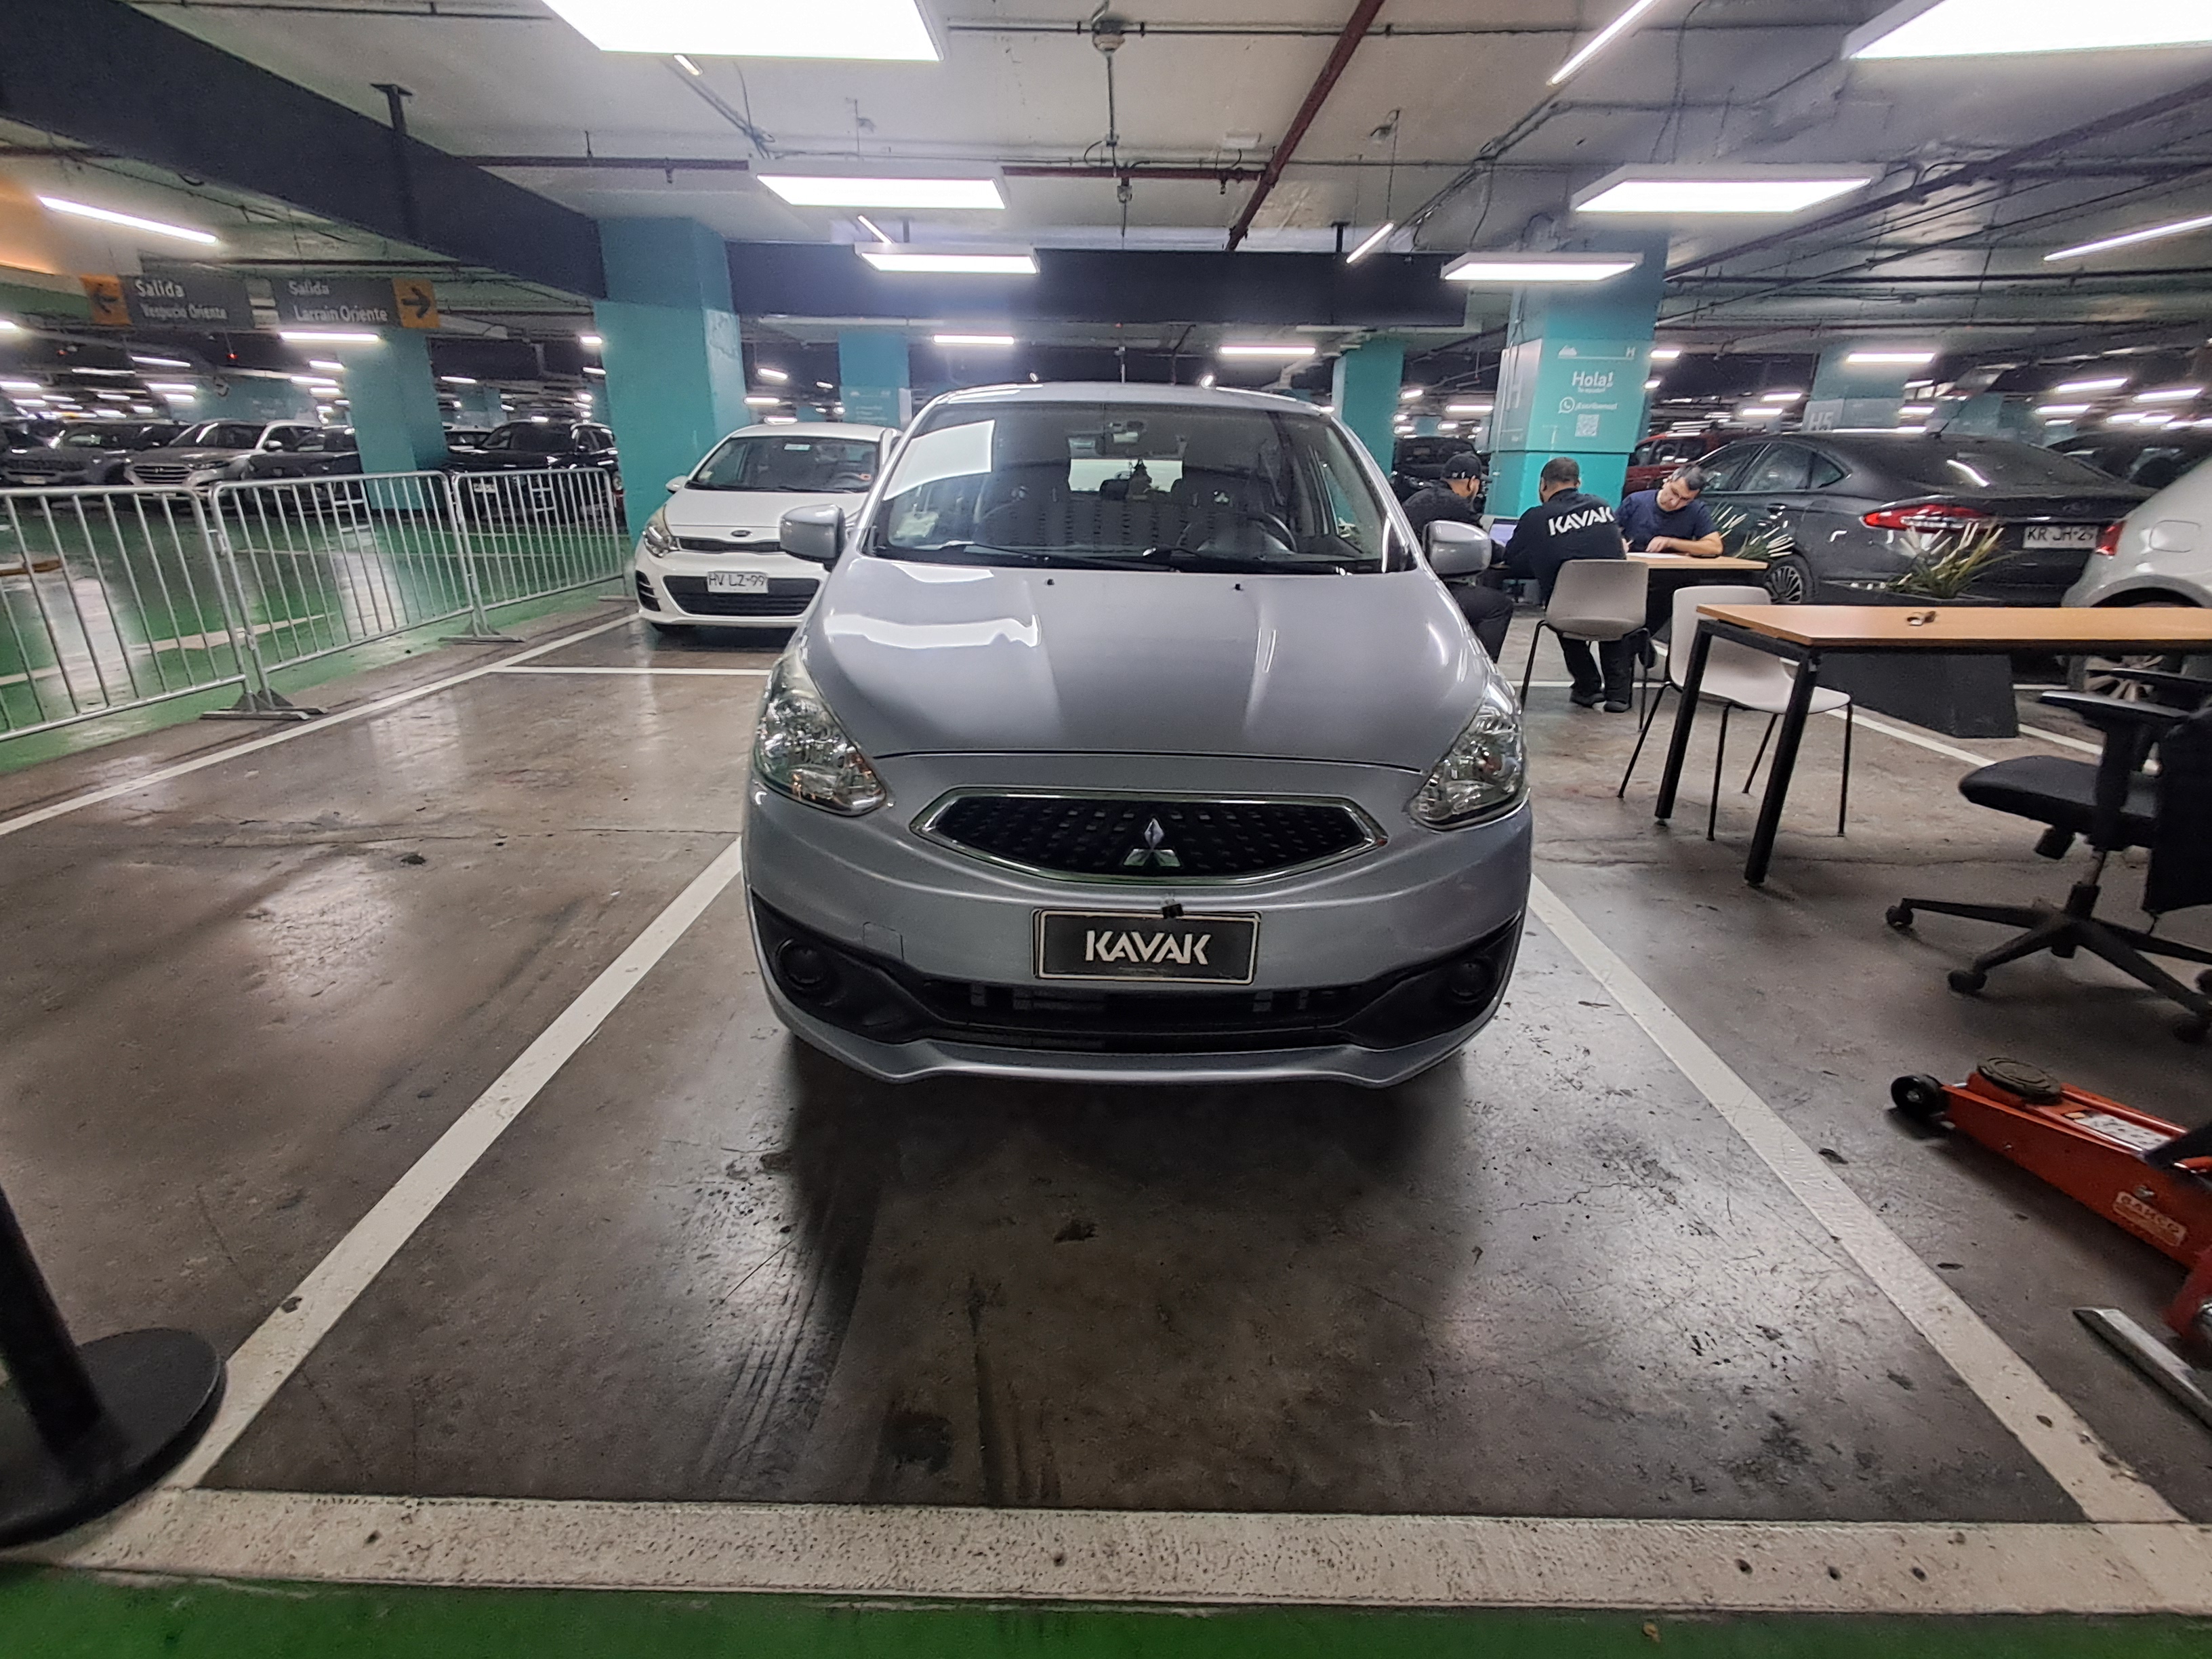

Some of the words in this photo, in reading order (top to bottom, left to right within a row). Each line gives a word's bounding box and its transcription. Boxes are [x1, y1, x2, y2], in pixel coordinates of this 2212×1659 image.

[136, 279, 185, 298] Salida
[289, 279, 330, 295] Salida
[340, 305, 388, 322] Oriente
[1572, 371, 1614, 388] Hola!
[1548, 506, 1615, 536] KAVAK
[1085, 930, 1211, 965] KAVAK
